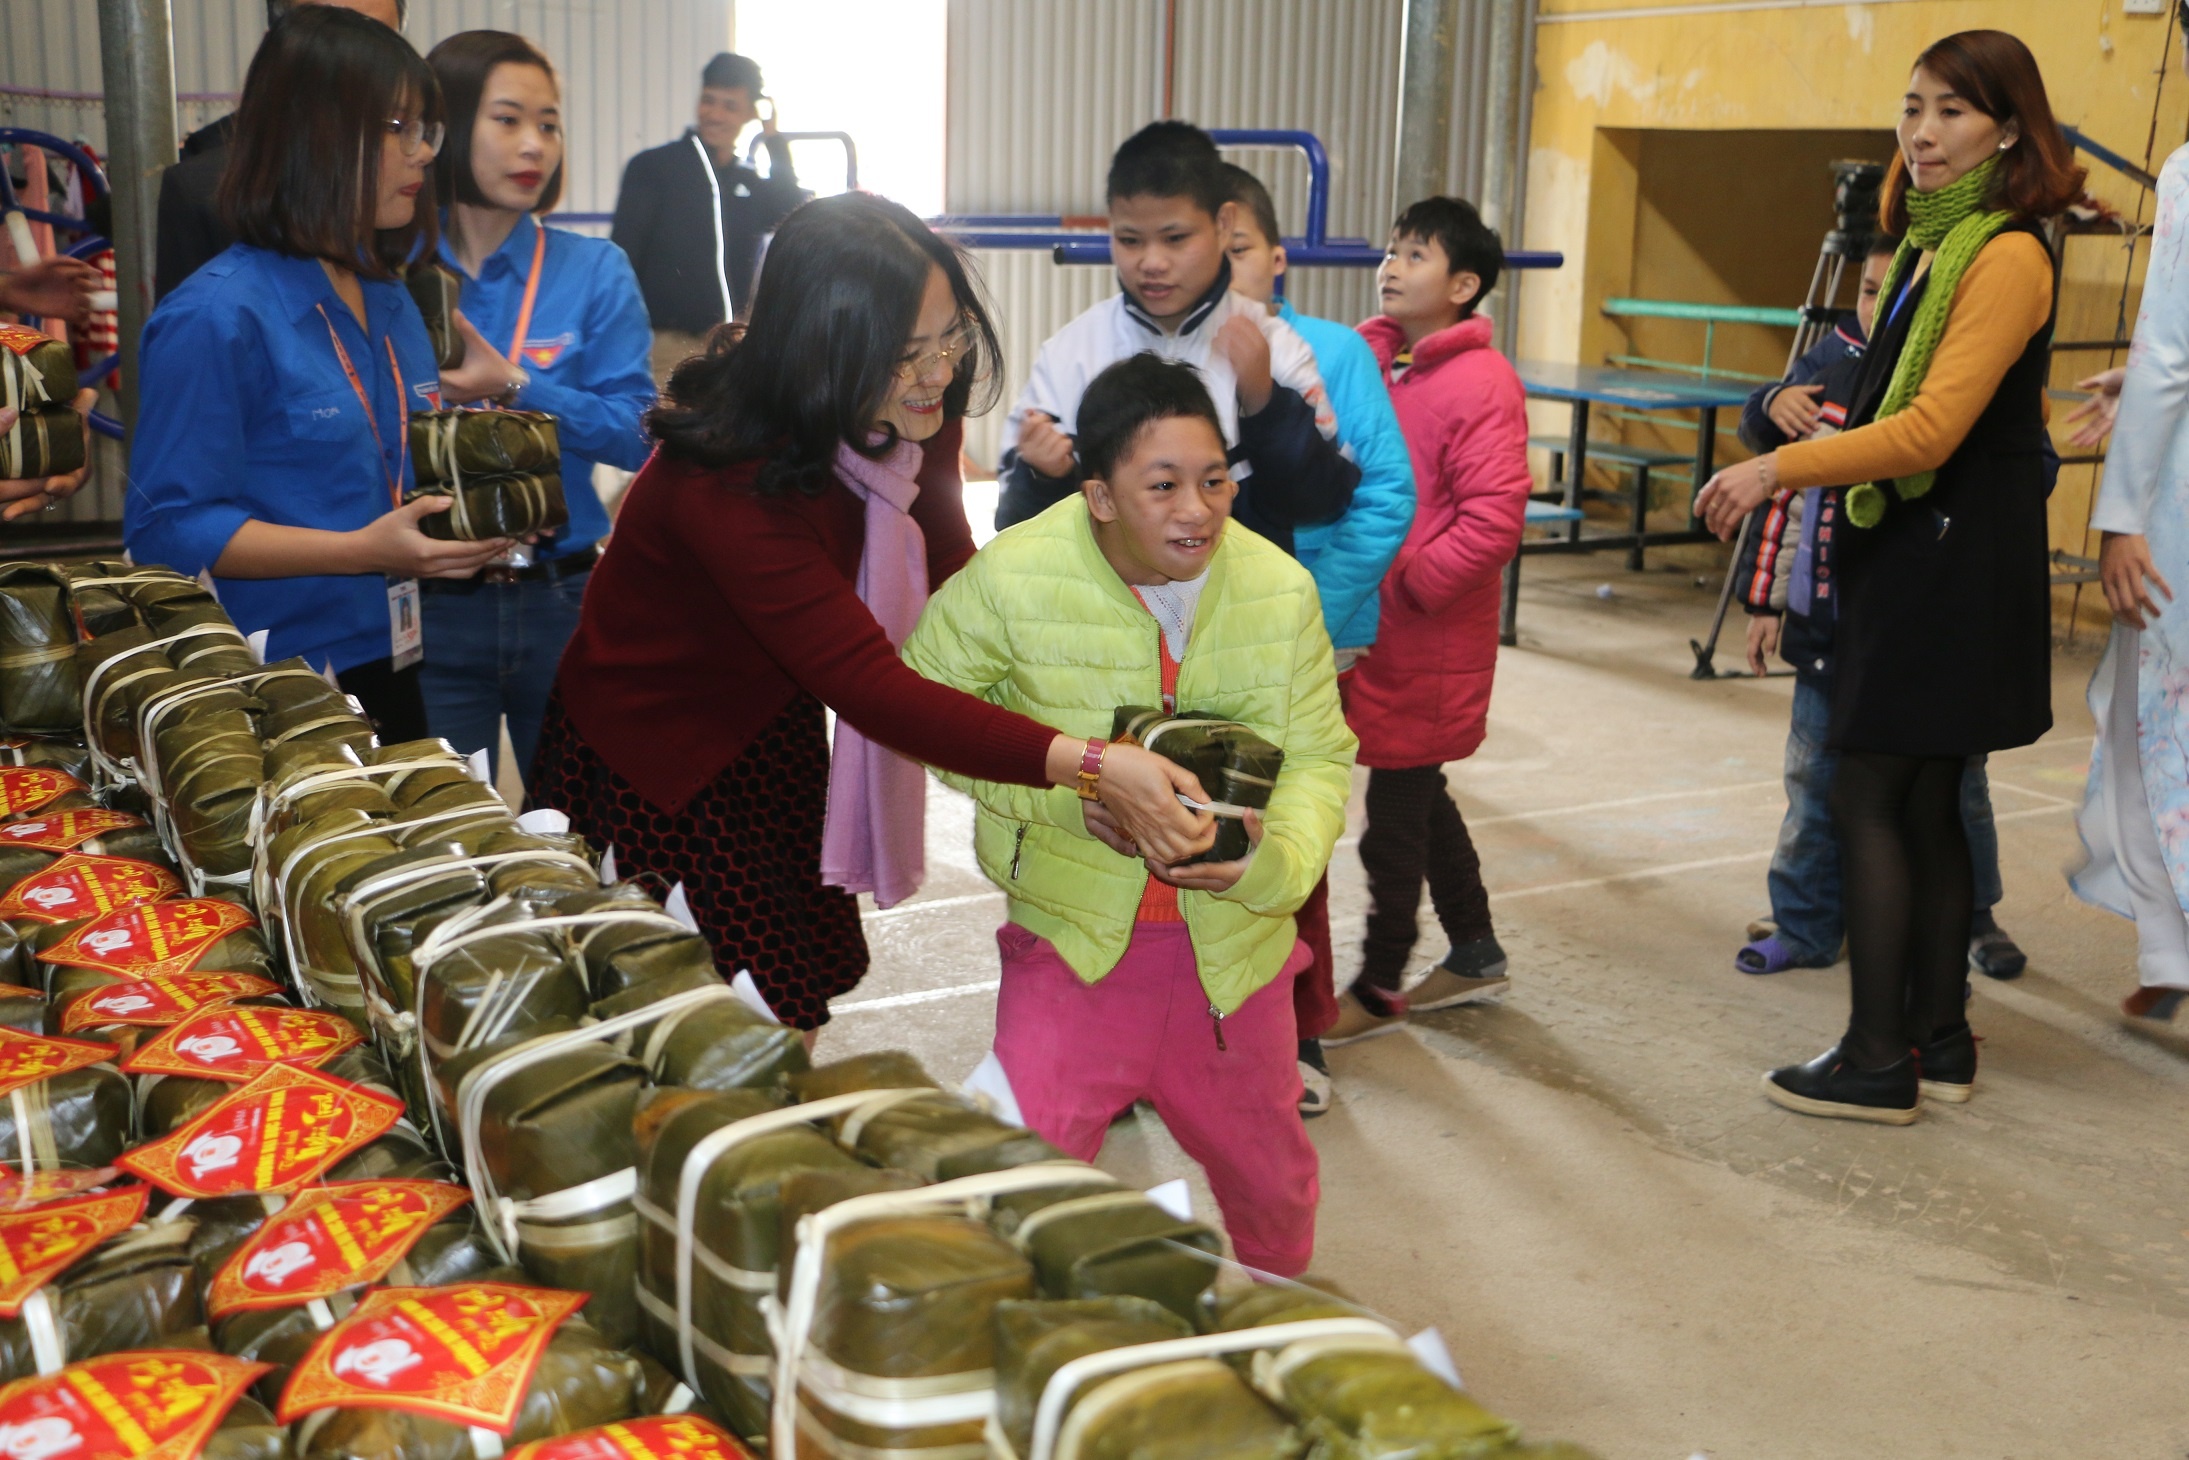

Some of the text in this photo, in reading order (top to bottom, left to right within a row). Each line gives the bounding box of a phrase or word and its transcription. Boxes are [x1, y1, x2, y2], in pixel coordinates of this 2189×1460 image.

[1816, 490, 1838, 598] ASHION
[33, 886, 77, 909] 10
[89, 928, 134, 956] 10
[191, 1036, 244, 1063] 10
[190, 1134, 243, 1179] 10
